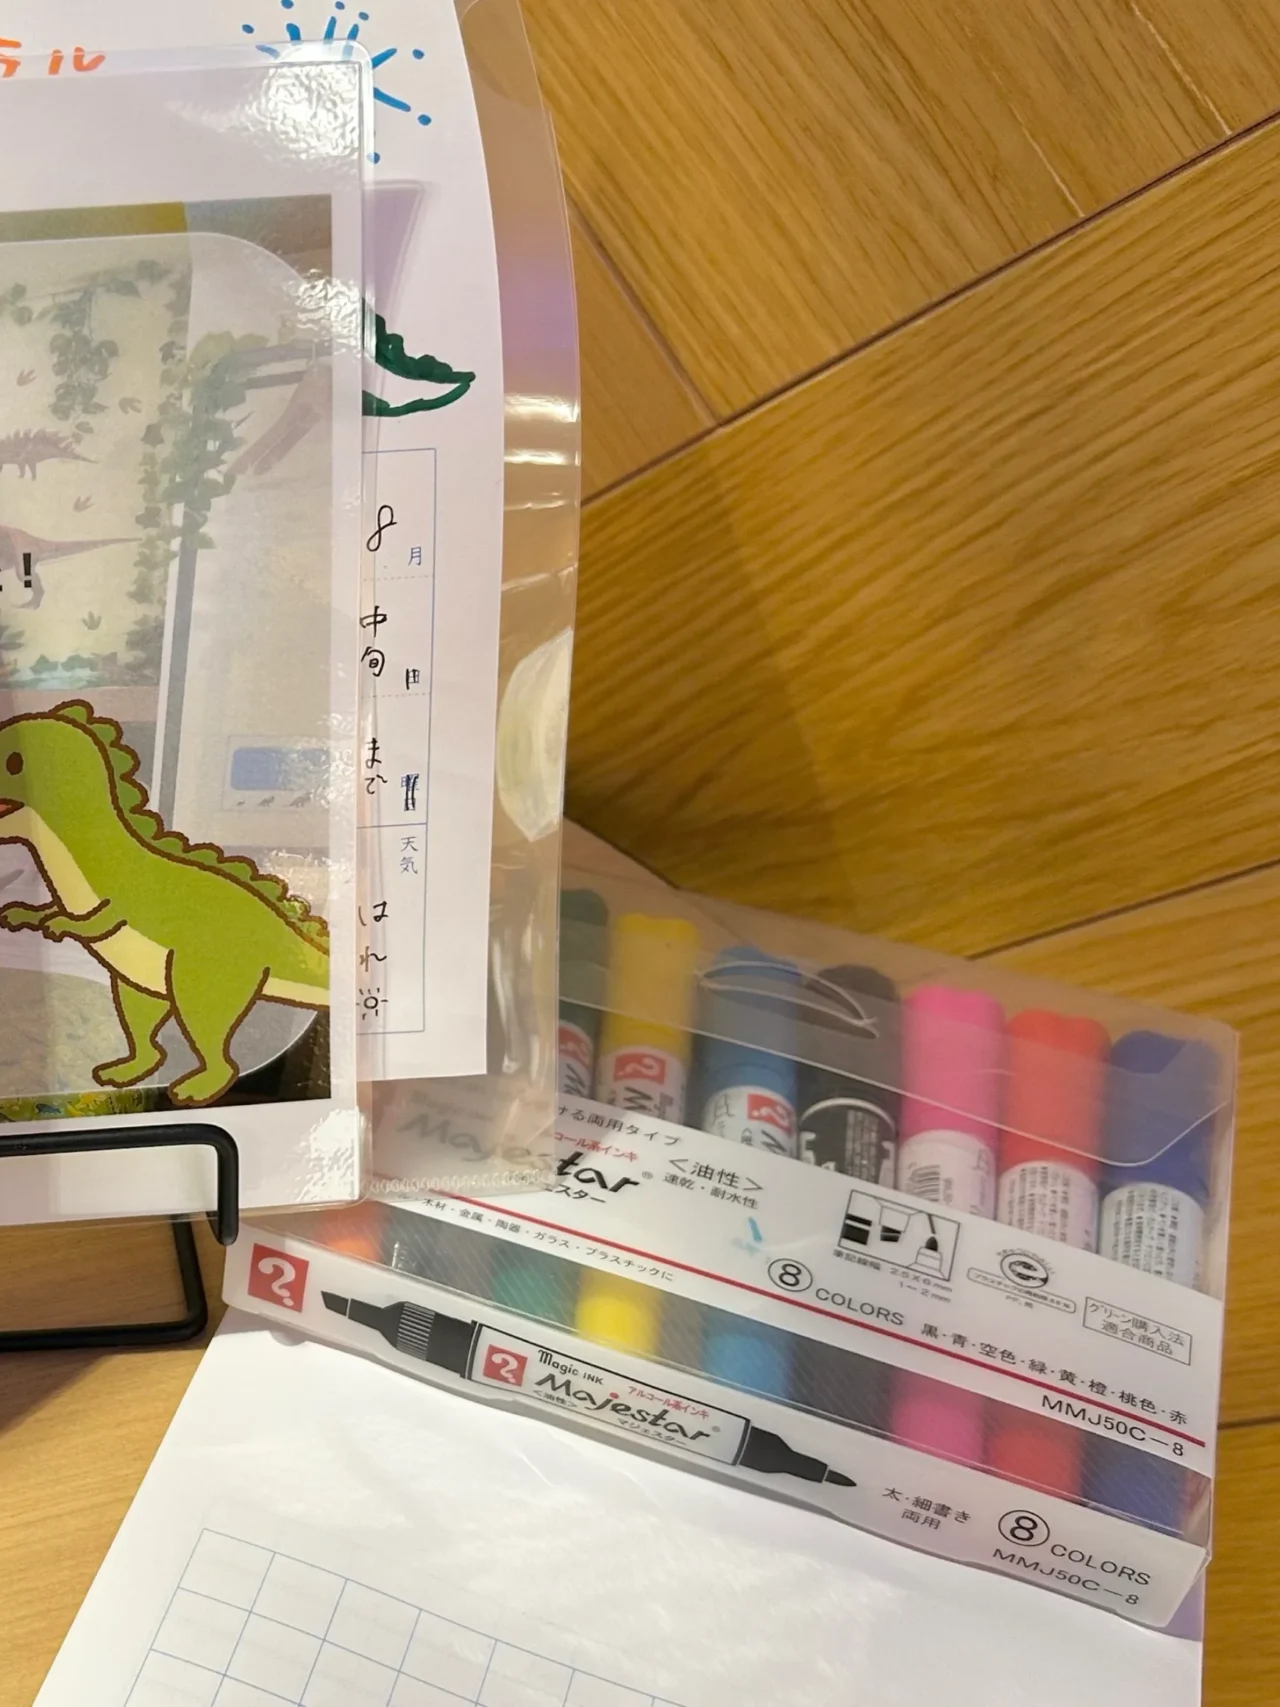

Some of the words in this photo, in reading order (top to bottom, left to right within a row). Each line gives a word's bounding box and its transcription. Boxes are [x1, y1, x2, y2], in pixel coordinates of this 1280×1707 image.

[366, 504, 397, 552] 8
[408, 546, 422, 566] 月
[360, 606, 387, 677] 中旬
[400, 836, 418, 874] 天気
[815, 1287, 905, 1327] COLORS
[1089, 1303, 1185, 1347] グリーン購入法
[1101, 1319, 1173, 1355] 適合商品
[538, 1349, 579, 1376] Magic
[583, 1372, 604, 1385] INK
[535, 1373, 711, 1441] Majestar
[901, 1508, 941, 1530] 両用
[1050, 1544, 1152, 1586] COLORS
